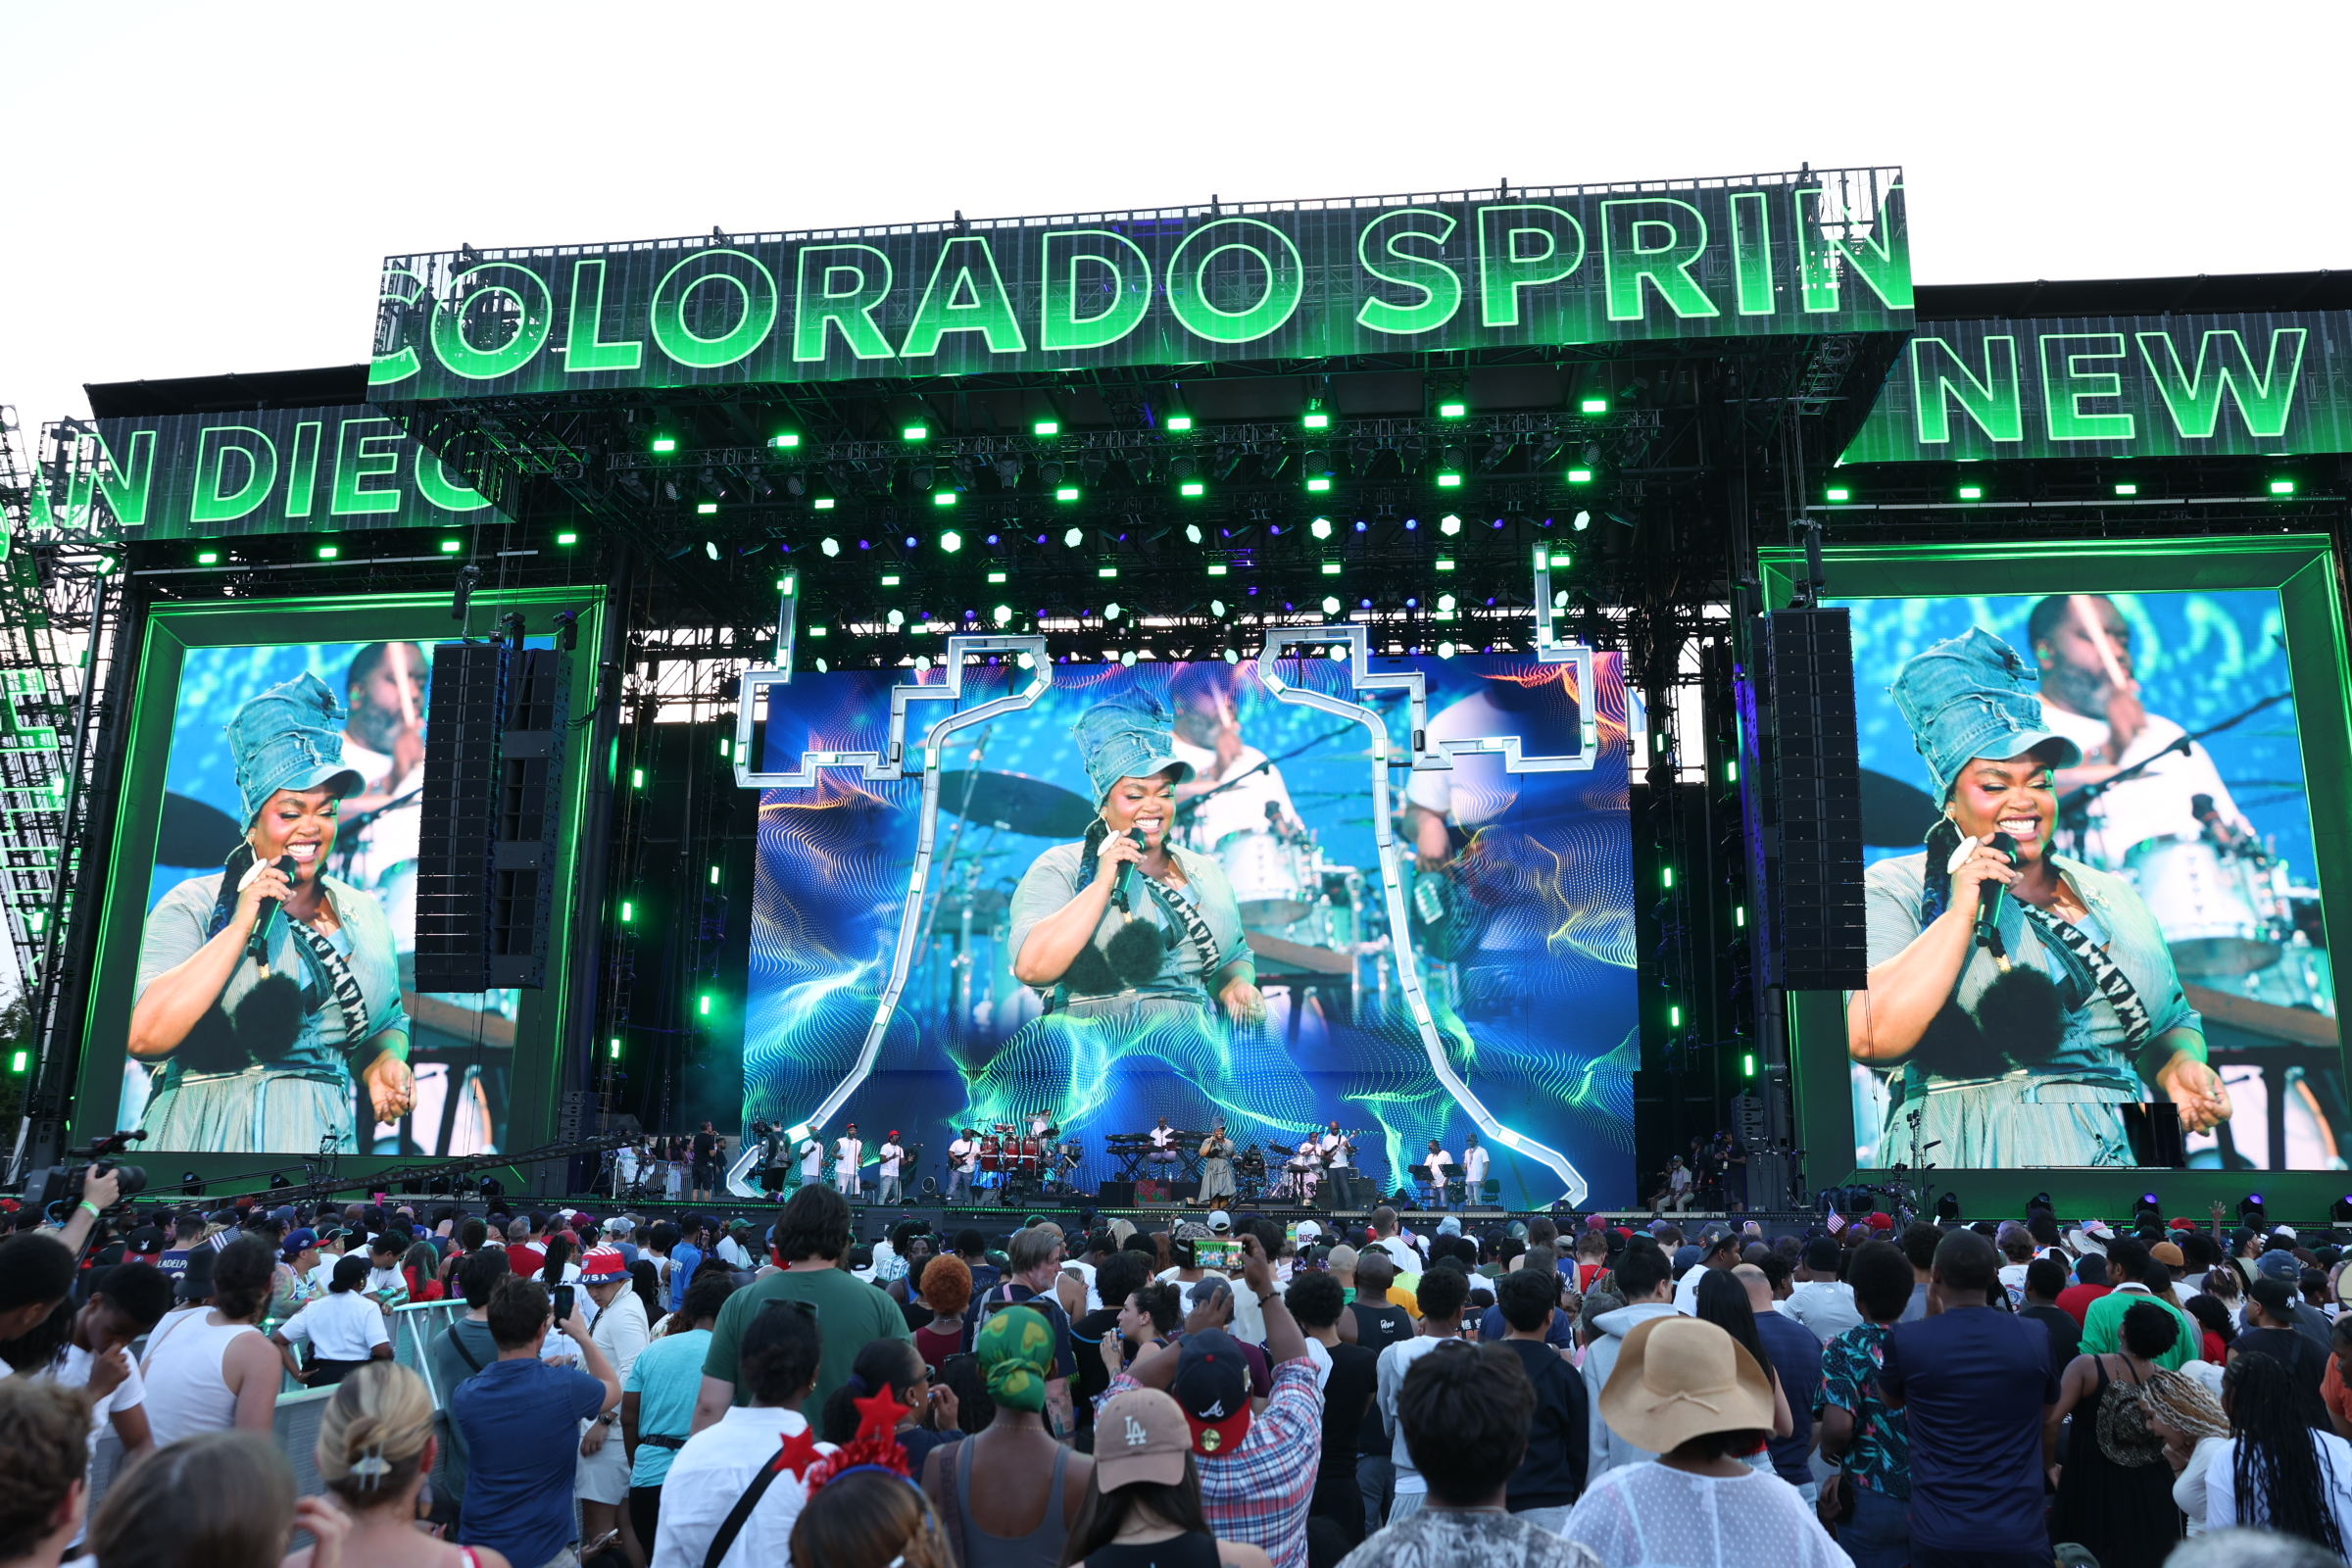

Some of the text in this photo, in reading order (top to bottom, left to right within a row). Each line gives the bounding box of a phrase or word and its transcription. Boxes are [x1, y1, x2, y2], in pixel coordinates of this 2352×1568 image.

[1910, 327, 2309, 445] NEW
[1298, 1233, 1313, 1243] BOS
[581, 1273, 610, 1283] USA
[2285, 1295, 2296, 1309] NY
[1199, 1399, 1224, 1418] A
[1124, 1415, 1148, 1446] LA
